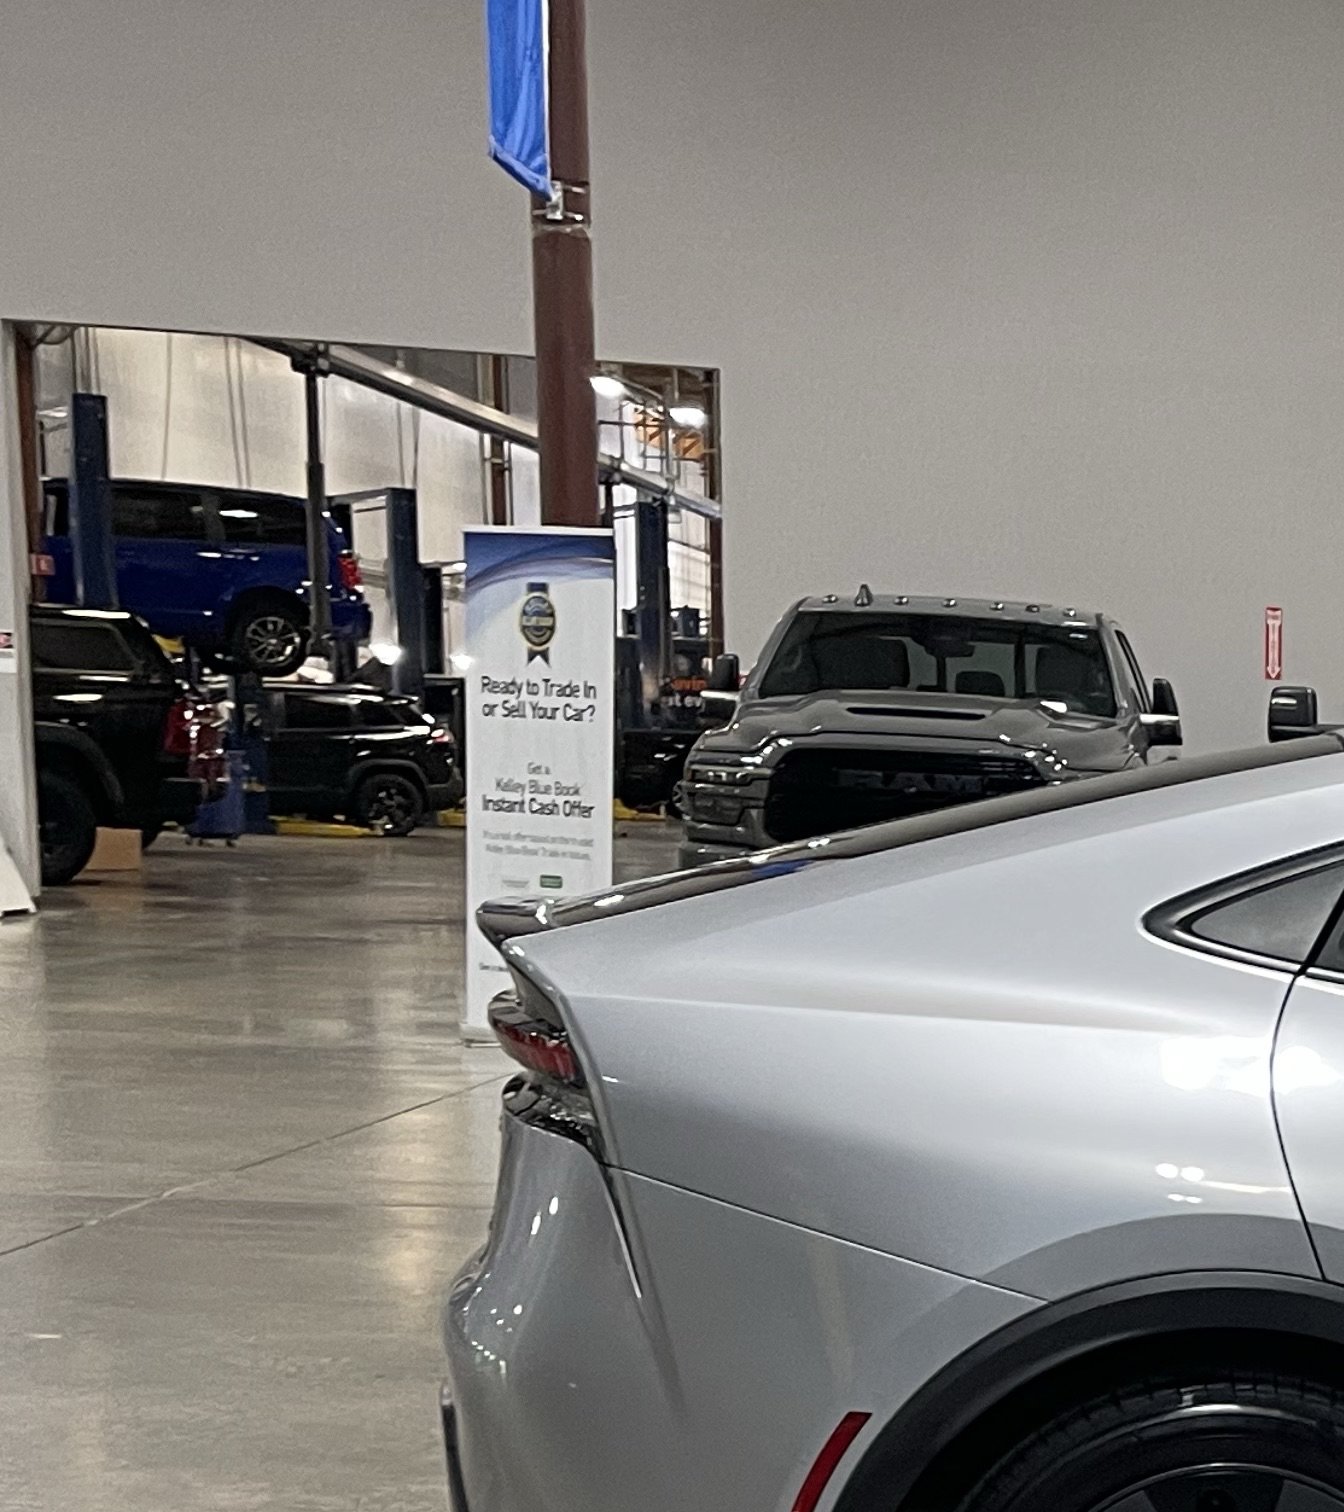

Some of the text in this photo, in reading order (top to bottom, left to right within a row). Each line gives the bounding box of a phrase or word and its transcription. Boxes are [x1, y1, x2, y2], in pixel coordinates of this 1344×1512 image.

[481, 675, 597, 699] Ready to Trade In
[482, 700, 596, 723] or Sell Your Car?
[495, 778, 581, 797] Kelley Blue Book
[481, 794, 595, 818] Instant Cash Offer
